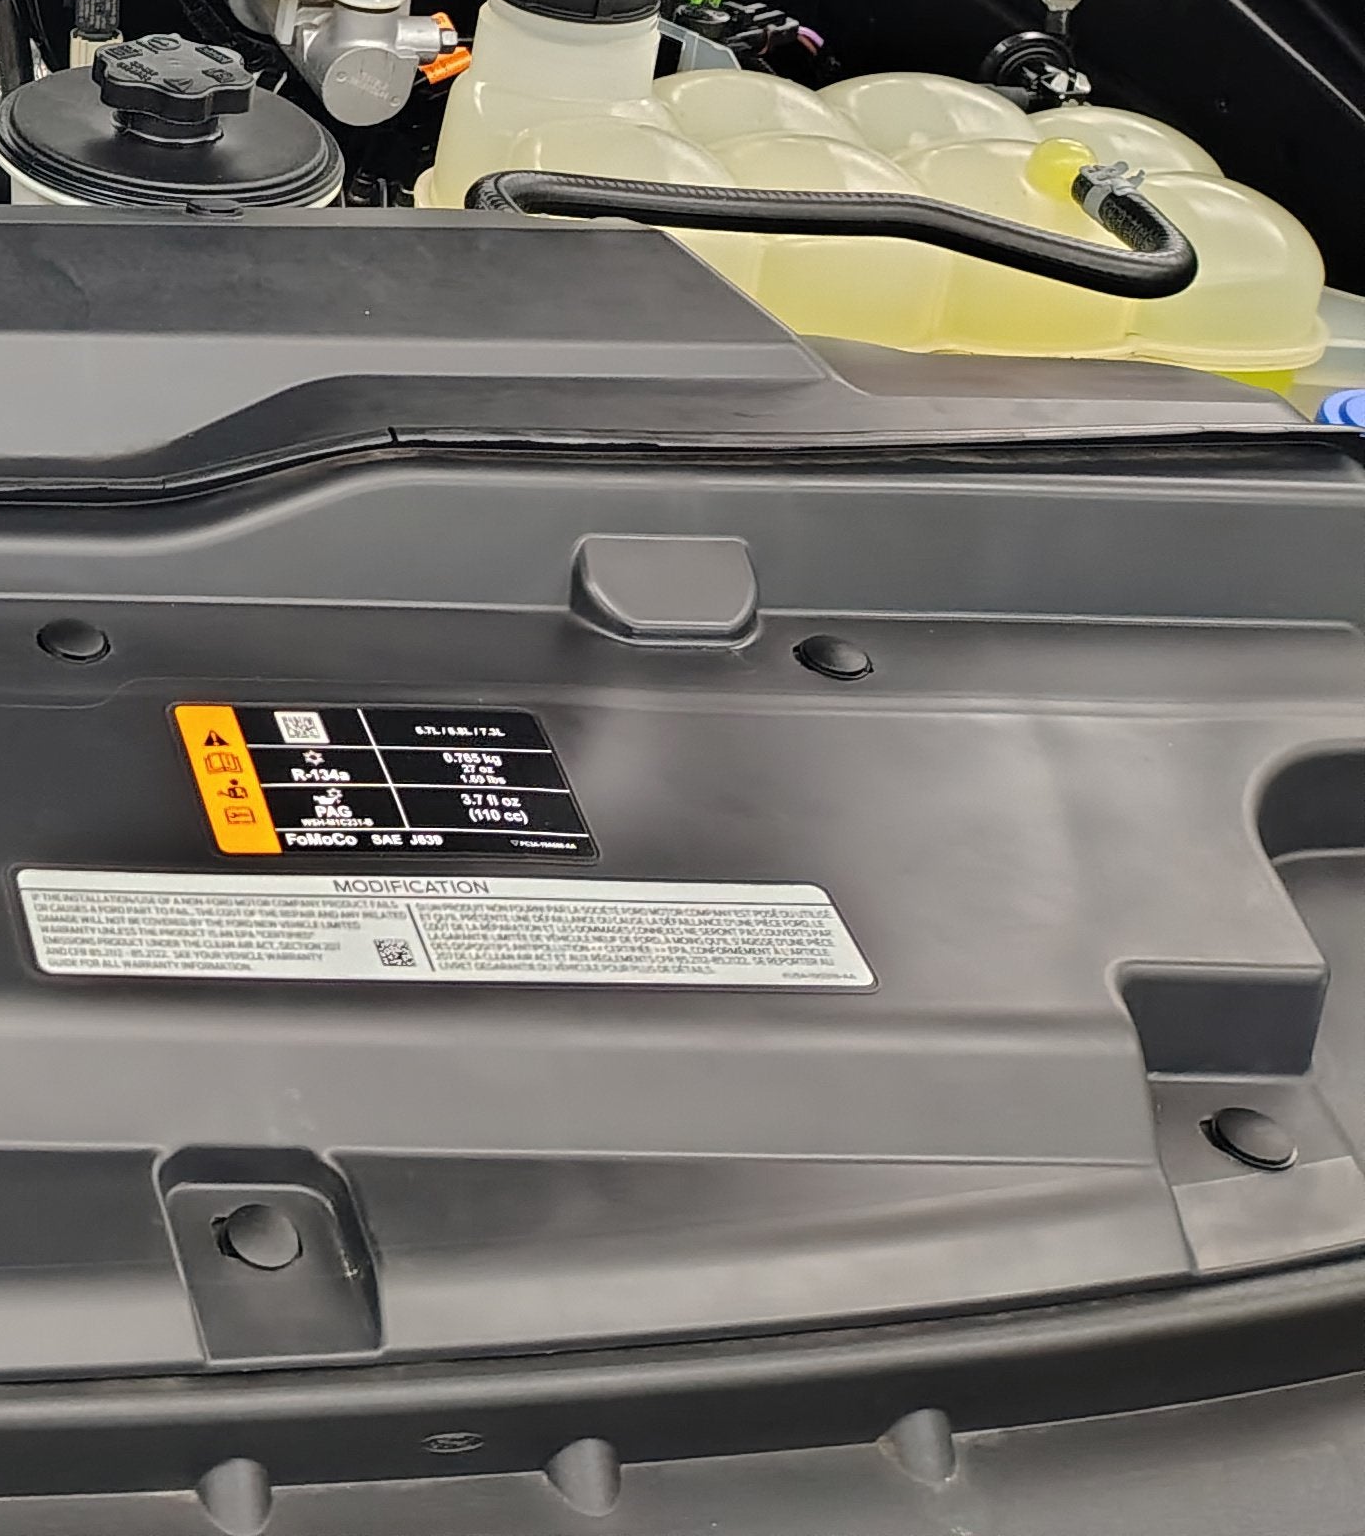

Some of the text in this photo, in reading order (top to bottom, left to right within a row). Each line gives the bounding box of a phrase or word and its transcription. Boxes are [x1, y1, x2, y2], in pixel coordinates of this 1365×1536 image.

[442, 752, 503, 767] 0.765 kg
[290, 768, 350, 783] R-134a
[461, 764, 495, 774] 27 oz
[486, 775, 507, 785] lbs
[460, 793, 521, 807] 3.7 fl oz
[314, 805, 352, 818] PAG
[469, 808, 529, 825] (110 cc)
[285, 832, 358, 846] FoMoCo
[371, 834, 444, 846] SAE J639
[333, 879, 490, 894] MODIFICATION
